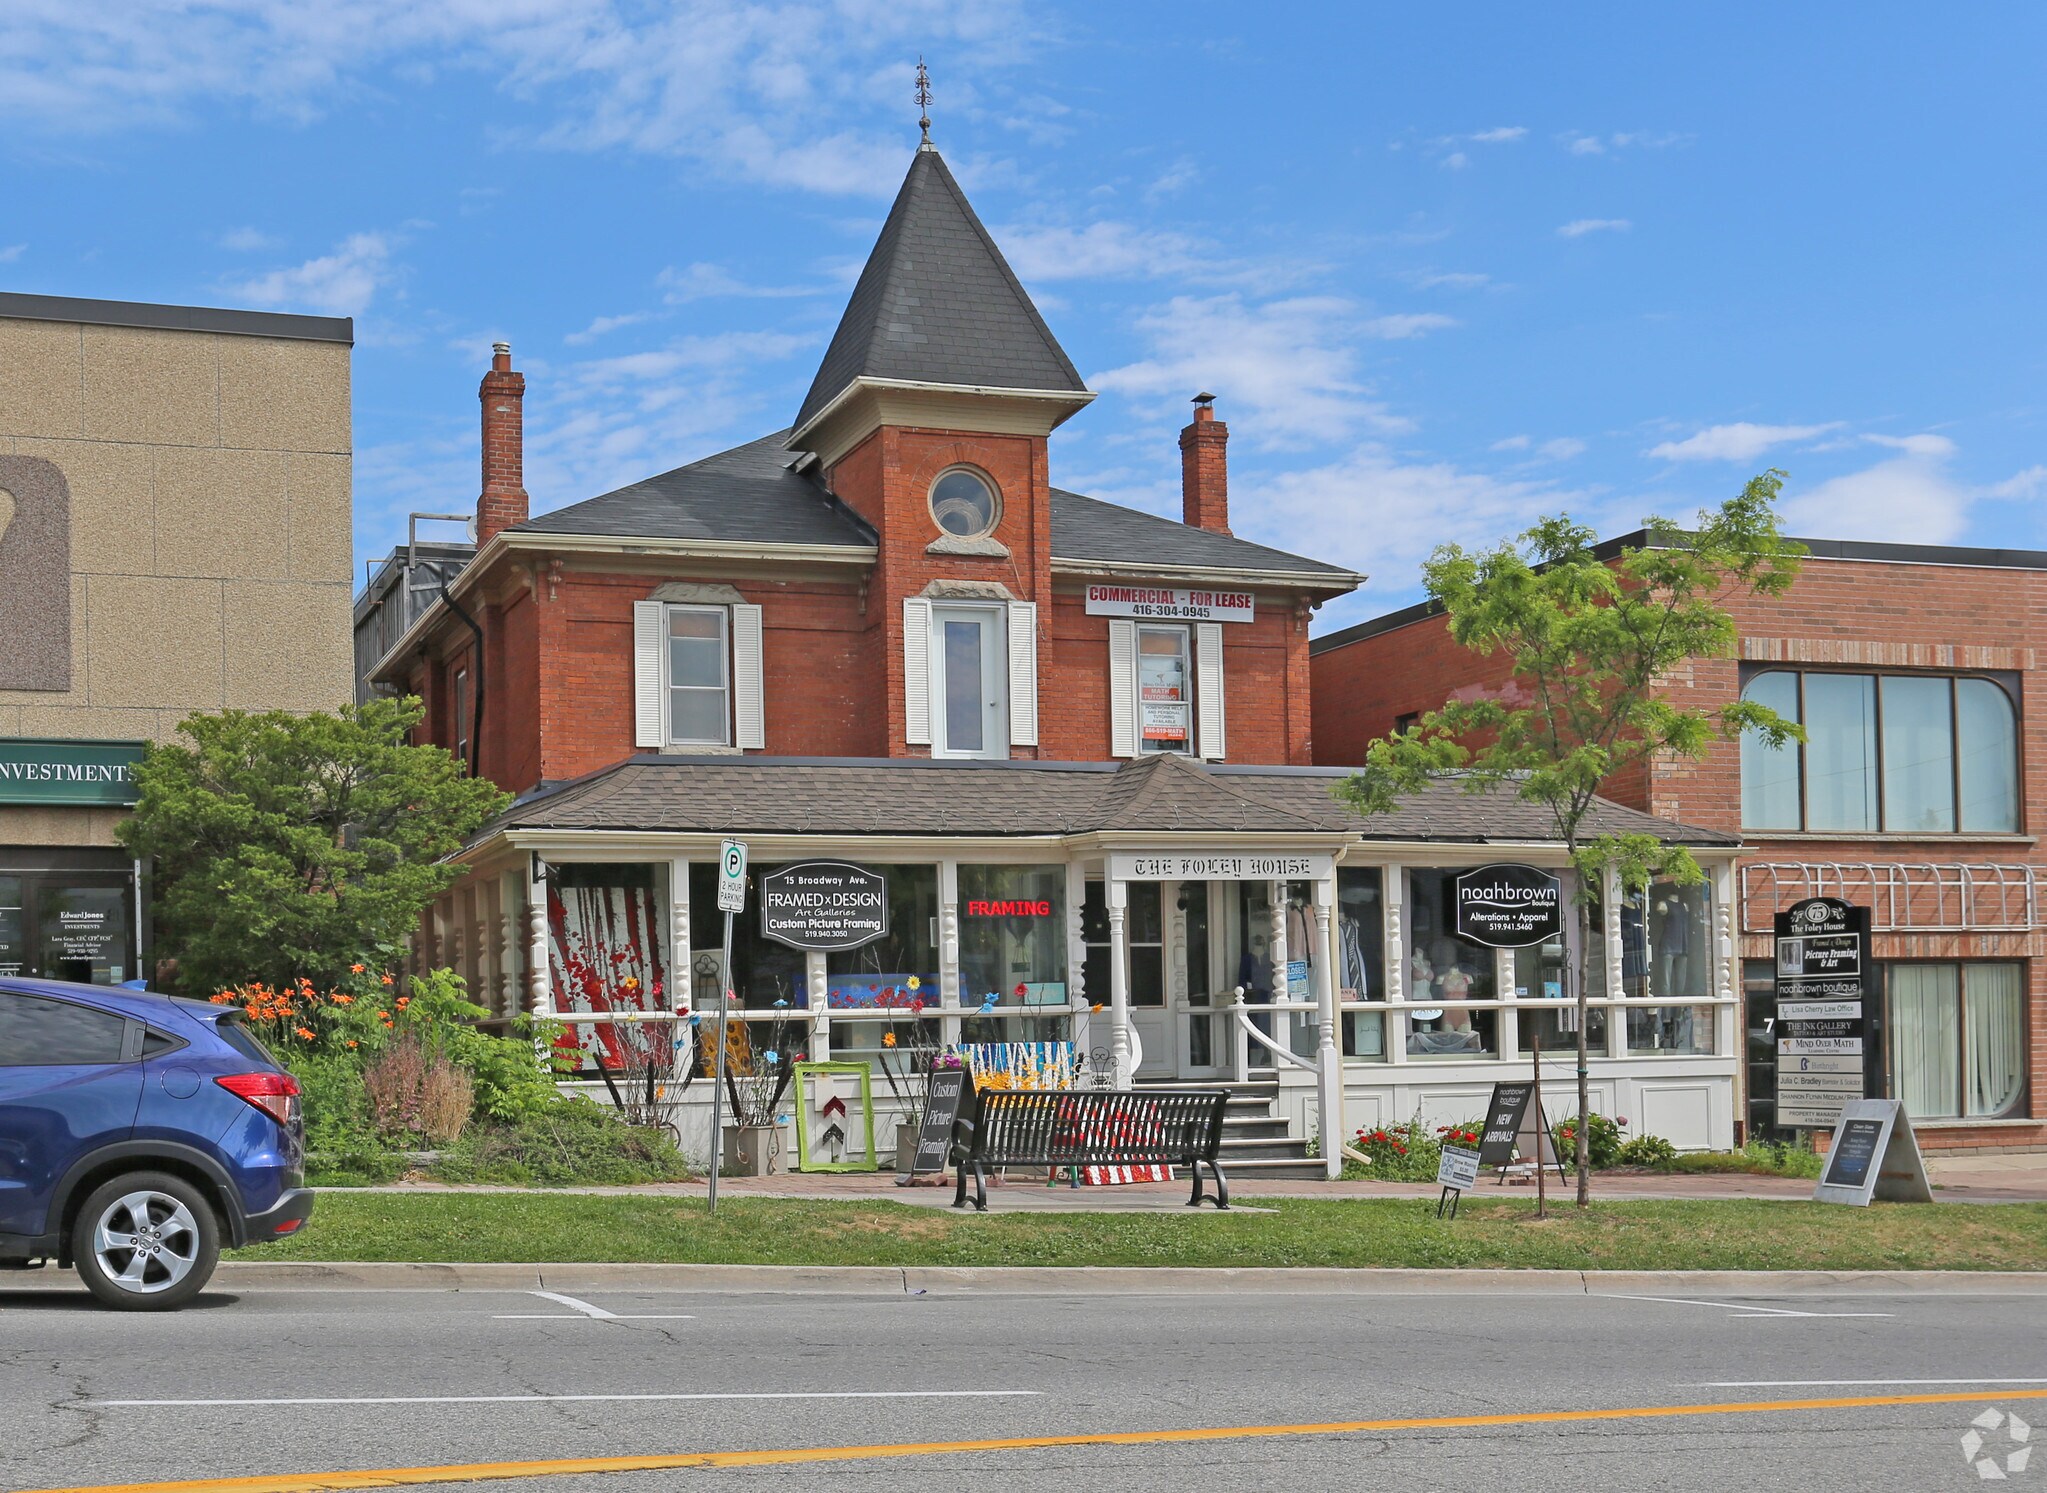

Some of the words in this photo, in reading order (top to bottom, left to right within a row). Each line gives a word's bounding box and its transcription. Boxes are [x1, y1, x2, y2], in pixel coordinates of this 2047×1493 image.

[1089, 586, 1175, 605] COMMERCIAL
[1189, 591, 1212, 607] FOR
[1215, 593, 1251, 609] LEASE
[1132, 604, 1210, 618] 416-304-0945
[729, 854, 738, 870] P
[1135, 859, 1172, 875] THE
[1180, 859, 1242, 878] FOLEY
[1250, 859, 1310, 875] HOUSE
[722, 881, 726, 890] 2
[727, 882, 742, 893] HOUR
[798, 876, 843, 887] Broadway
[849, 876, 867, 885] Ave.
[1462, 882, 1556, 900] noahbrown
[721, 892, 743, 904] PARKING
[794, 908, 812, 917] Art
[814, 908, 856, 917] Galleries
[968, 900, 1050, 917] FRAMING
[1811, 906, 1824, 919] 75
[1470, 912, 1510, 921] Alterations
[1519, 912, 1548, 923] Apparel
[769, 919, 806, 929] Custom
[808, 919, 841, 929] Picture
[843, 919, 880, 931] Framing
[1489, 923, 1533, 931] 519.941.5460
[1791, 924, 1804, 932] The
[1804, 923, 1823, 933] Foley
[1823, 923, 1845, 931] House
[804, 930, 848, 938] 519.940.3050
[1805, 949, 1829, 959] Picture
[1830, 948, 1858, 959] Framing
[1820, 959, 1827, 967] &
[1827, 958, 1839, 967] Art
[1780, 984, 1822, 994] noahbrown
[1823, 982, 1858, 993] boutique
[1804, 1005, 1823, 1014] Cherry
[1837, 1004, 1854, 1012] Office
[1786, 1022, 1802, 1031] THE
[1802, 1022, 1816, 1031] INK
[1816, 1021, 1852, 1031] GALLERY
[1796, 1039, 1814, 1048] MIND
[1833, 1039, 1854, 1048] MATH
[1780, 1077, 1793, 1085] Julia
[1800, 1077, 1822, 1086] Bradley
[932, 1082, 959, 1097] Custom
[1500, 1096, 1521, 1104] boutique
[927, 1109, 952, 1126] Picture
[1496, 1113, 1513, 1125] NEW
[1483, 1130, 1514, 1143] ARRIVALS
[918, 1137, 949, 1162] Framing
